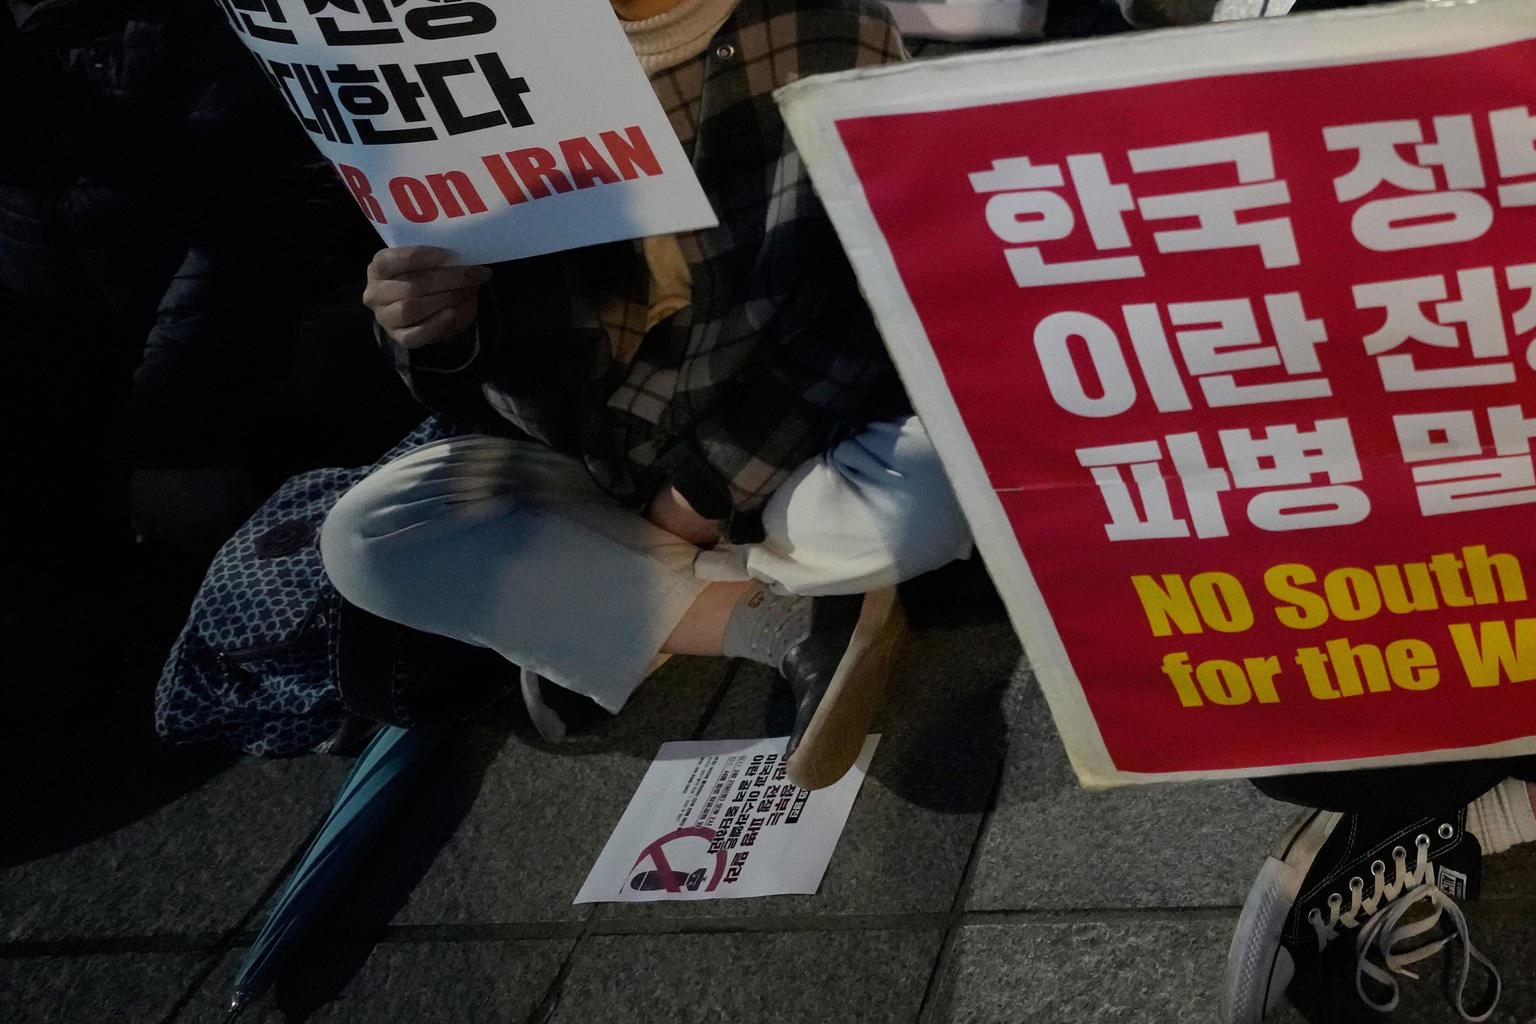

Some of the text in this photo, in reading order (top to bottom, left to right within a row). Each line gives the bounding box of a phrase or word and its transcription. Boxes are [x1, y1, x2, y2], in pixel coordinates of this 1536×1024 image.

[252, 52, 535, 146] 대한다
[388, 169, 485, 224] on
[481, 125, 663, 206] IRAN
[968, 130, 1301, 289] 한국
[1032, 294, 1334, 422] 이란
[1074, 416, 1373, 544] 파병
[1130, 566, 1251, 640] NO
[1274, 544, 1527, 632] South
[1161, 647, 1284, 709] for
[1297, 636, 1440, 701] the
[731, 779, 752, 802] 공격
[743, 754, 764, 776] 이란
[752, 753, 778, 787] 미국과
[720, 790, 762, 850] 이스라엘은
[755, 784, 780, 812] 전쟁
[765, 784, 796, 825] 정부는
[705, 805, 739, 854] 중단하라
[739, 817, 765, 846] 파병
[720, 851, 750, 883] 말라
